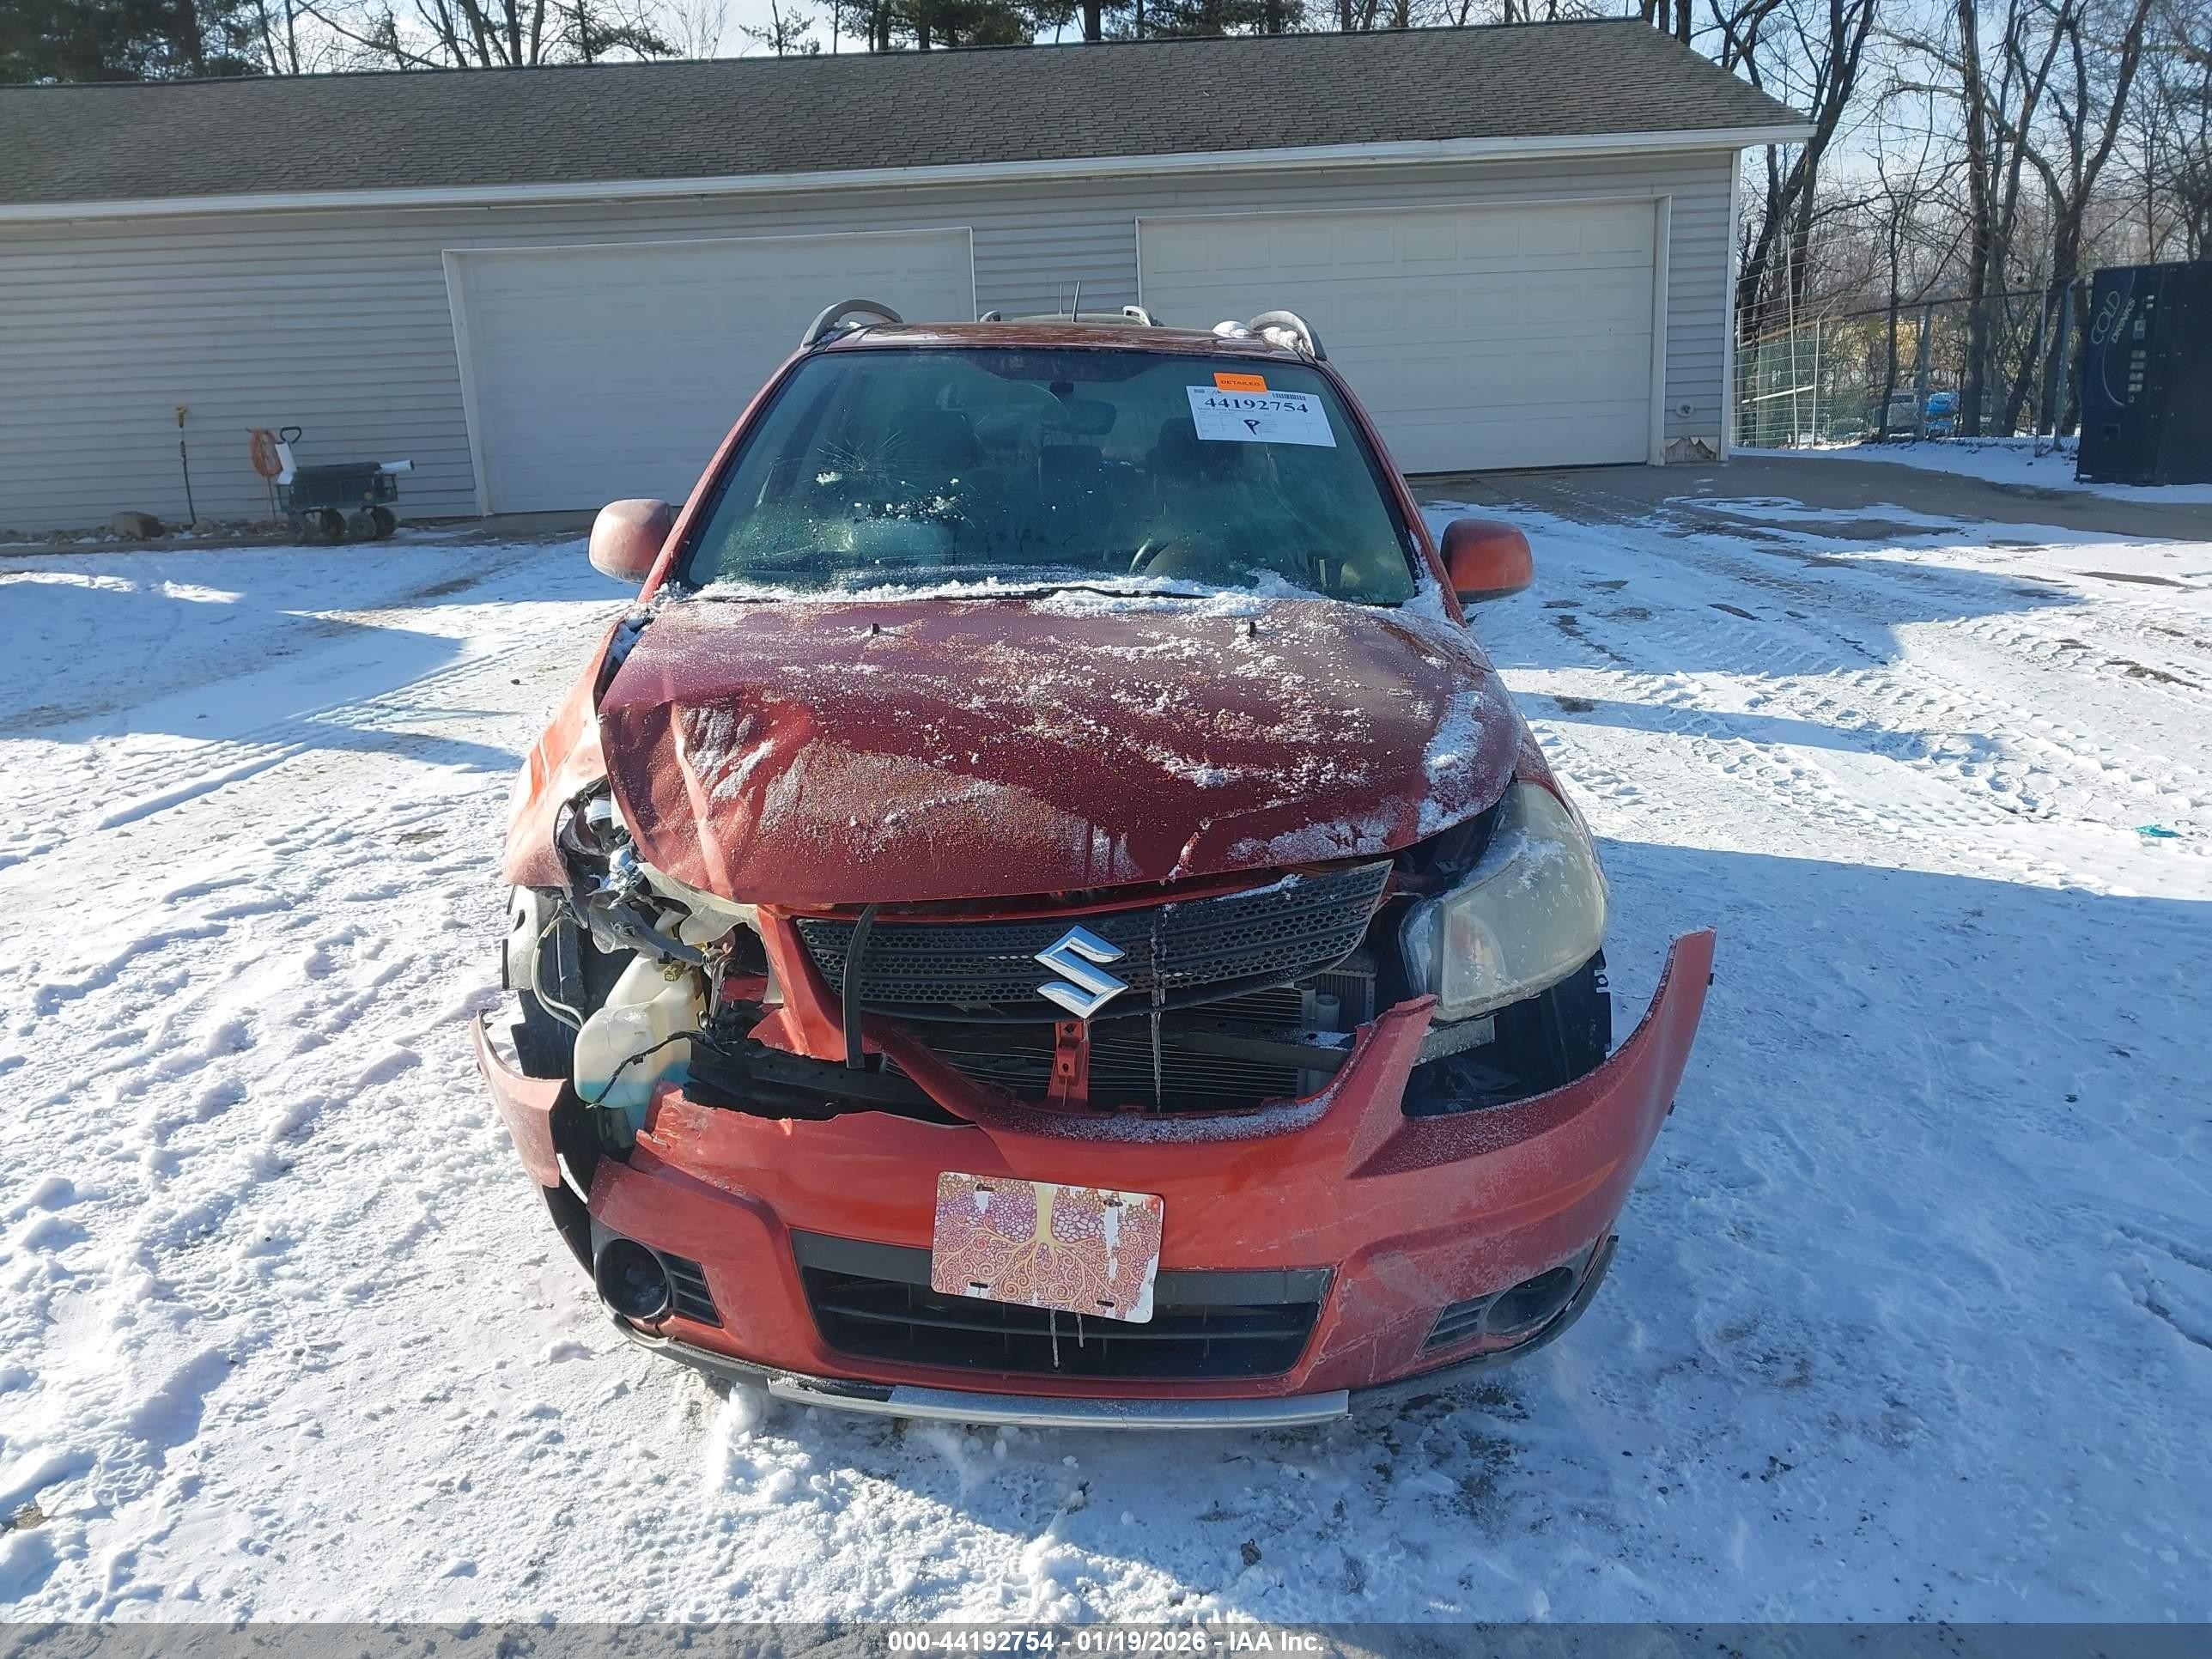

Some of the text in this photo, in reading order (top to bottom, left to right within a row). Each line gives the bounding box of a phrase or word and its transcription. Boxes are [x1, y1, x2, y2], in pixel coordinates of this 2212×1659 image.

[2090, 290, 2121, 344] COLD
[2111, 297, 2136, 343] DRINKS
[1204, 398, 1309, 413] 44192754
